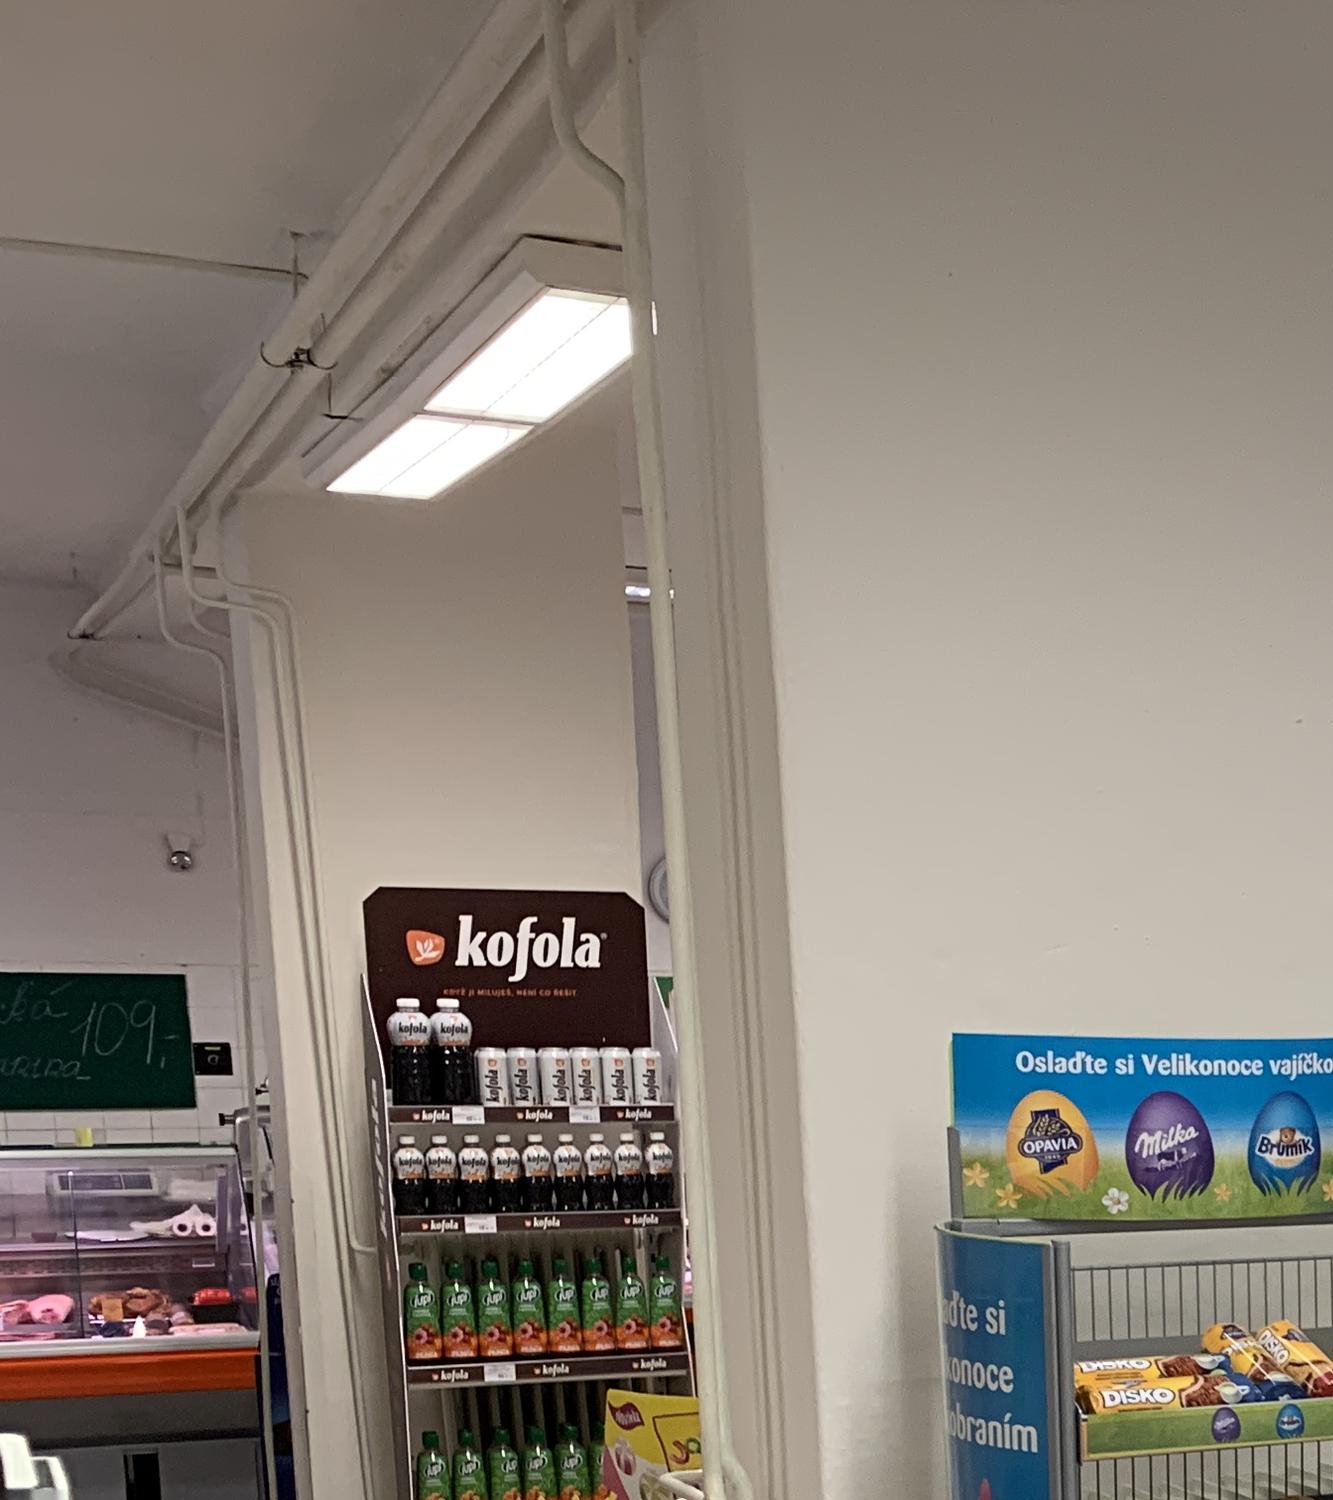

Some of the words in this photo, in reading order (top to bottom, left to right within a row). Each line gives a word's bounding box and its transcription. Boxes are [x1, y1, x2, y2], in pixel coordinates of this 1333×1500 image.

[455, 914, 601, 983] kofola
[398, 1022, 428, 1037] kofola
[440, 1022, 469, 1037] kofola
[1015, 1050, 1108, 1076] Oslaďte
[1114, 1053, 1135, 1076] si
[1141, 1052, 1264, 1077] Velikonoce
[421, 1109, 450, 1122] kofola
[525, 1109, 553, 1122] kofola
[625, 1107, 652, 1120] kofola
[1022, 1136, 1078, 1155] OPAVIA
[1135, 1124, 1199, 1158] Milka
[430, 1219, 459, 1232] kofola
[533, 1216, 560, 1229] kofola
[985, 1299, 1006, 1336] si
[1259, 1328, 1288, 1365] DISKO
[1102, 1386, 1177, 1409] DISKO
